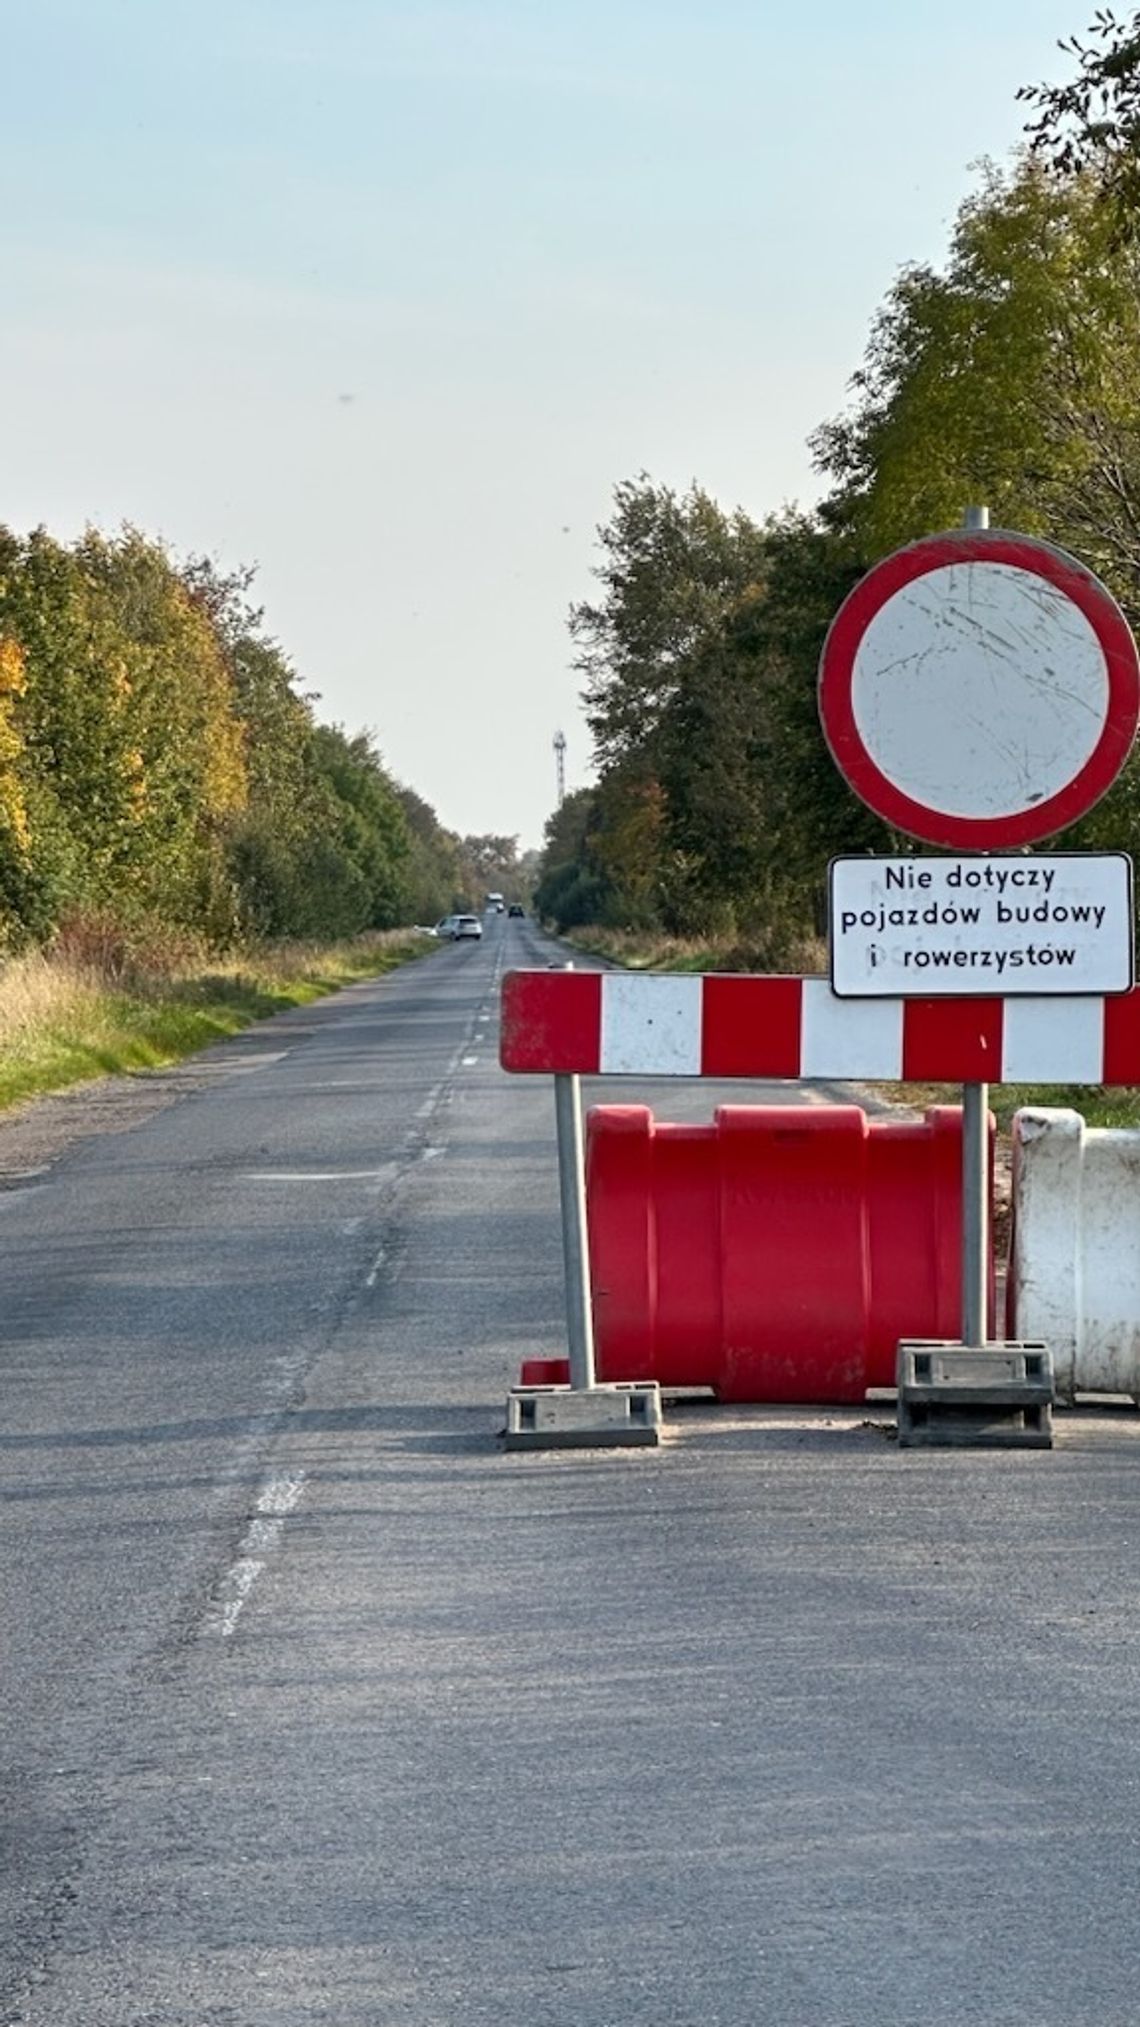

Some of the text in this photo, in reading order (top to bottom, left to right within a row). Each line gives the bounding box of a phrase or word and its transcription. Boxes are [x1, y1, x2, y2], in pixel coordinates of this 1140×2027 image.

[886, 866, 932, 889] Nie
[946, 864, 1056, 893] dotyczy
[841, 901, 1106, 934] pojazdów budowy
[870, 942, 1076, 974] i rowerzystów
